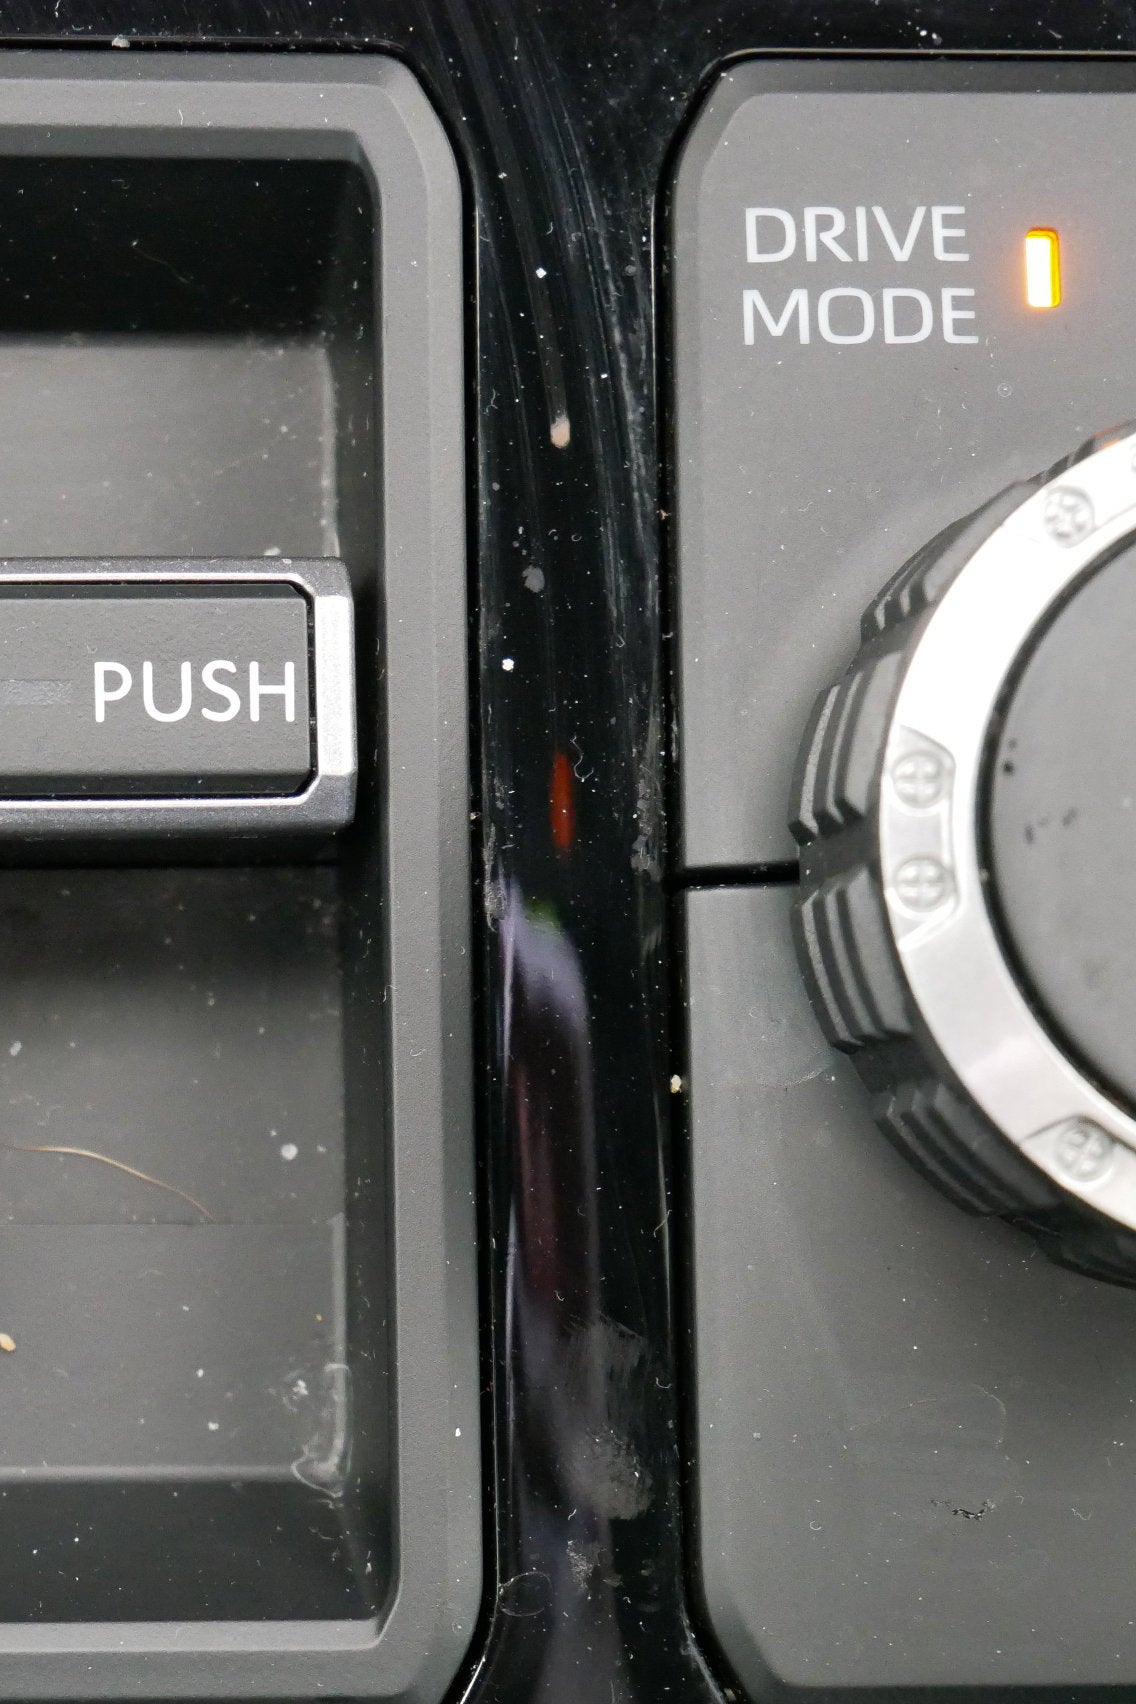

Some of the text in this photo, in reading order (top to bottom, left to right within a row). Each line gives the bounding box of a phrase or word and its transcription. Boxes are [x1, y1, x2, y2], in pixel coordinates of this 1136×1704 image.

[745, 205, 970, 263] DRIVE
[742, 287, 979, 346] MODE
[93, 659, 296, 723] PUSH
